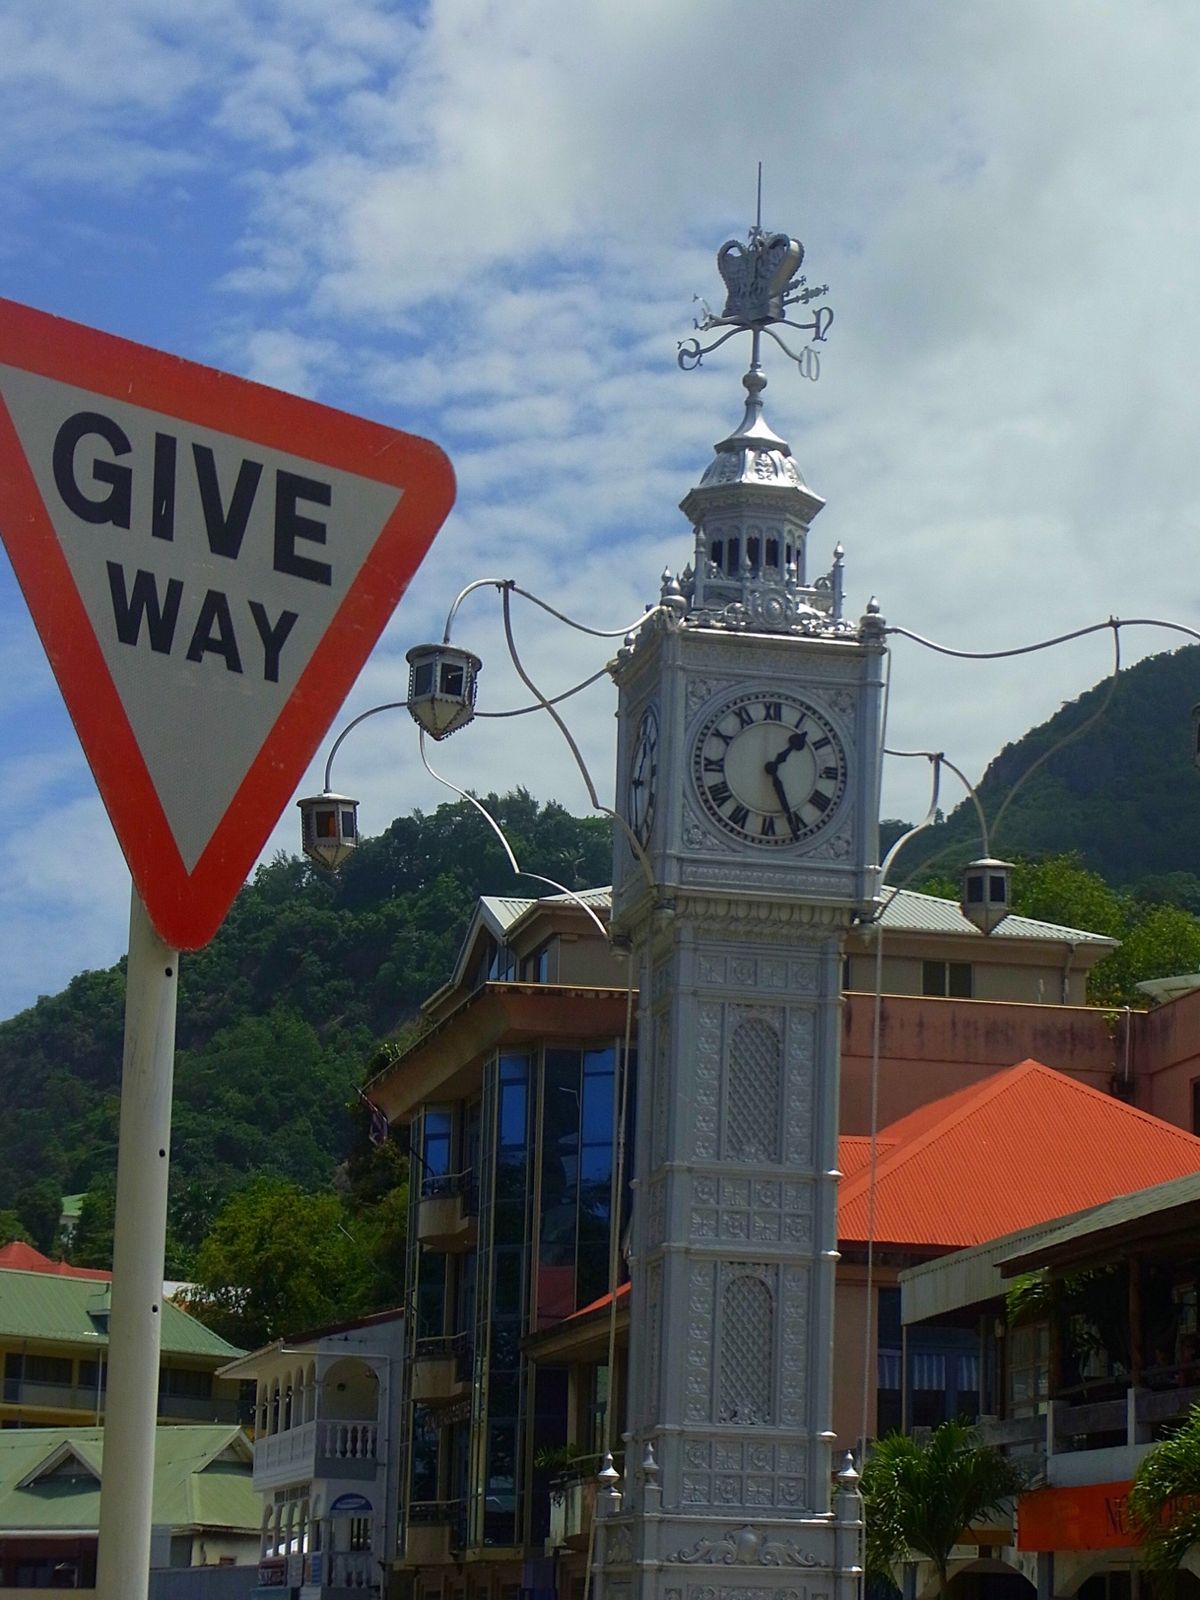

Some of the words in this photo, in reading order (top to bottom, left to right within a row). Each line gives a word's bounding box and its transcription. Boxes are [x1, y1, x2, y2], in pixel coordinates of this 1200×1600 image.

[52, 411, 332, 586] GIVE
[106, 560, 299, 683] WAY
[764, 702, 782, 721] XII
